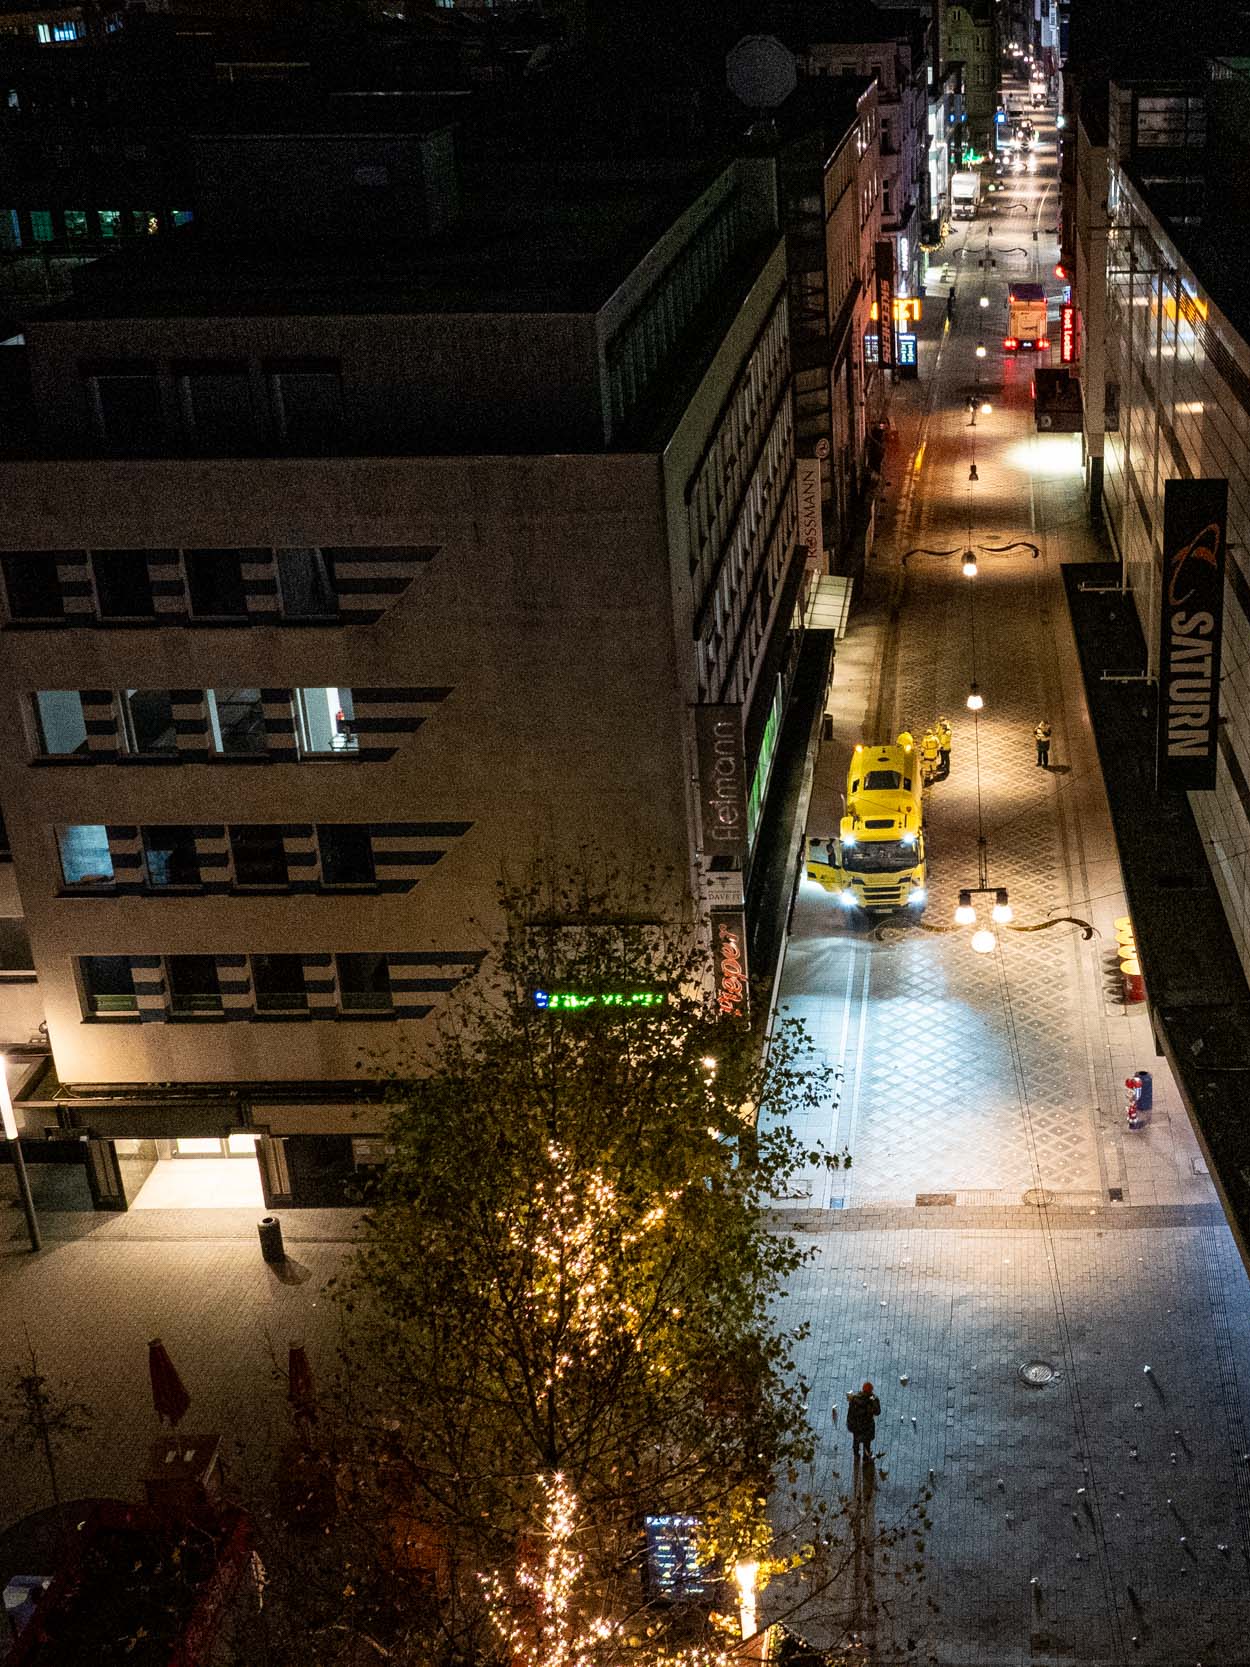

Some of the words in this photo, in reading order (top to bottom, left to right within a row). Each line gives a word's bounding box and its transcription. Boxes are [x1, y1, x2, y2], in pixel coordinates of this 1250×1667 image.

[1064, 308, 1073, 329] Foot
[1064, 330, 1073, 361] Locker
[802, 469, 817, 559] ROSSMANN
[1167, 610, 1215, 757] SATURN
